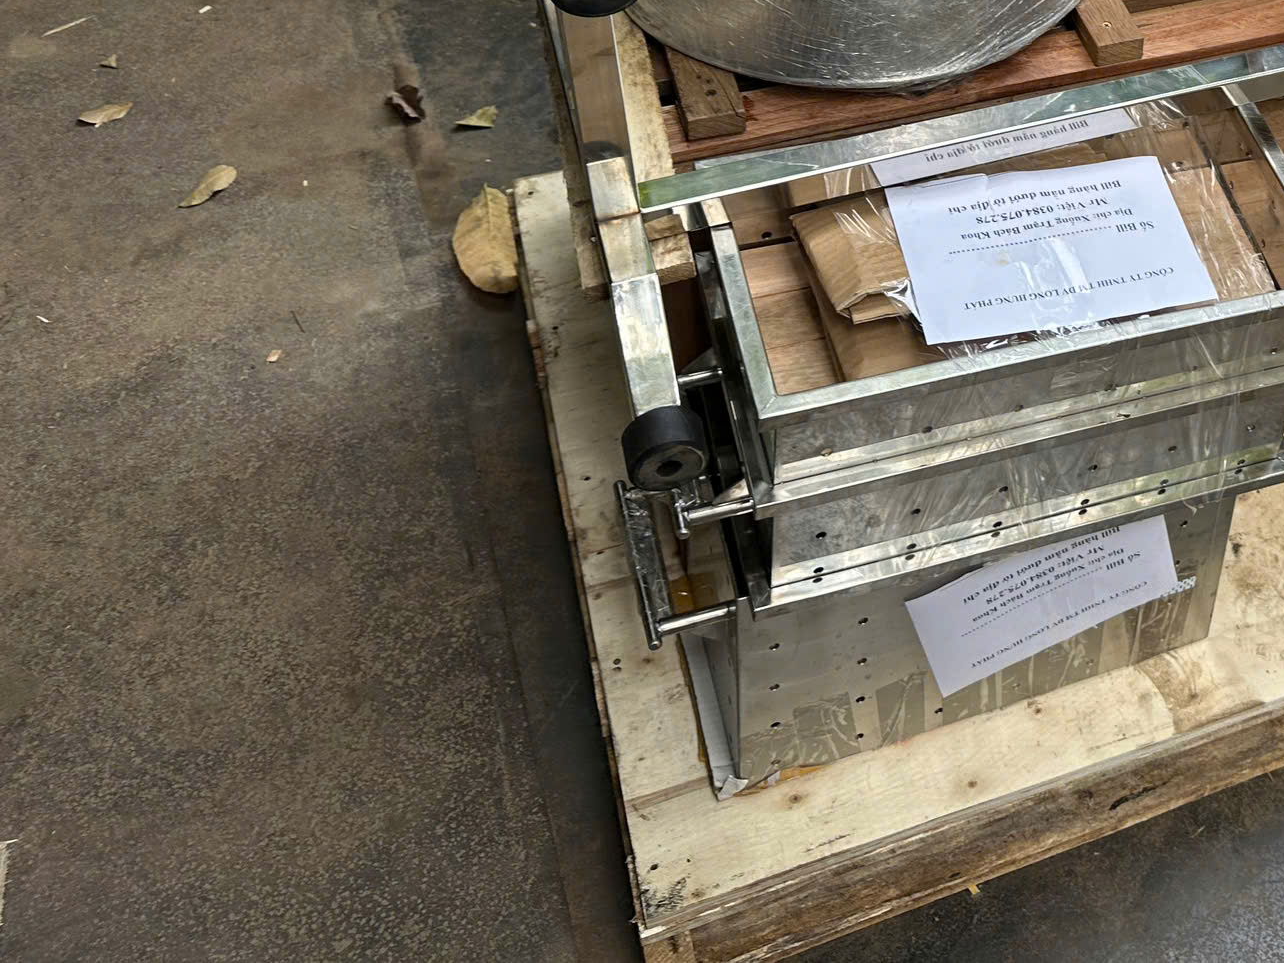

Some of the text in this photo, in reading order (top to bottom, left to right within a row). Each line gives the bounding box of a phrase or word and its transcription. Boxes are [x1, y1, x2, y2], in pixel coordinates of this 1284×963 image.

[1099, 178, 1121, 190] Bill
[1086, 194, 1108, 208] Mr
[973, 201, 1054, 226] 0384.075.278
[1117, 204, 1133, 218] Địa
[992, 224, 1021, 239] Bách
[1020, 216, 1053, 233] Trạm
[1114, 218, 1155, 234] Số Bill
[959, 228, 990, 244] Khoa
[1095, 274, 1126, 289] TNHH
[1127, 271, 1143, 284] TY
[1142, 265, 1175, 283] CÔNG
[1027, 287, 1059, 302] LONG
[1060, 284, 1076, 296] DV
[961, 296, 993, 315] PHÁT
[1084, 541, 1105, 558] Mr
[1103, 555, 1126, 572] Bill
[983, 564, 1057, 606] 0384.075.278
